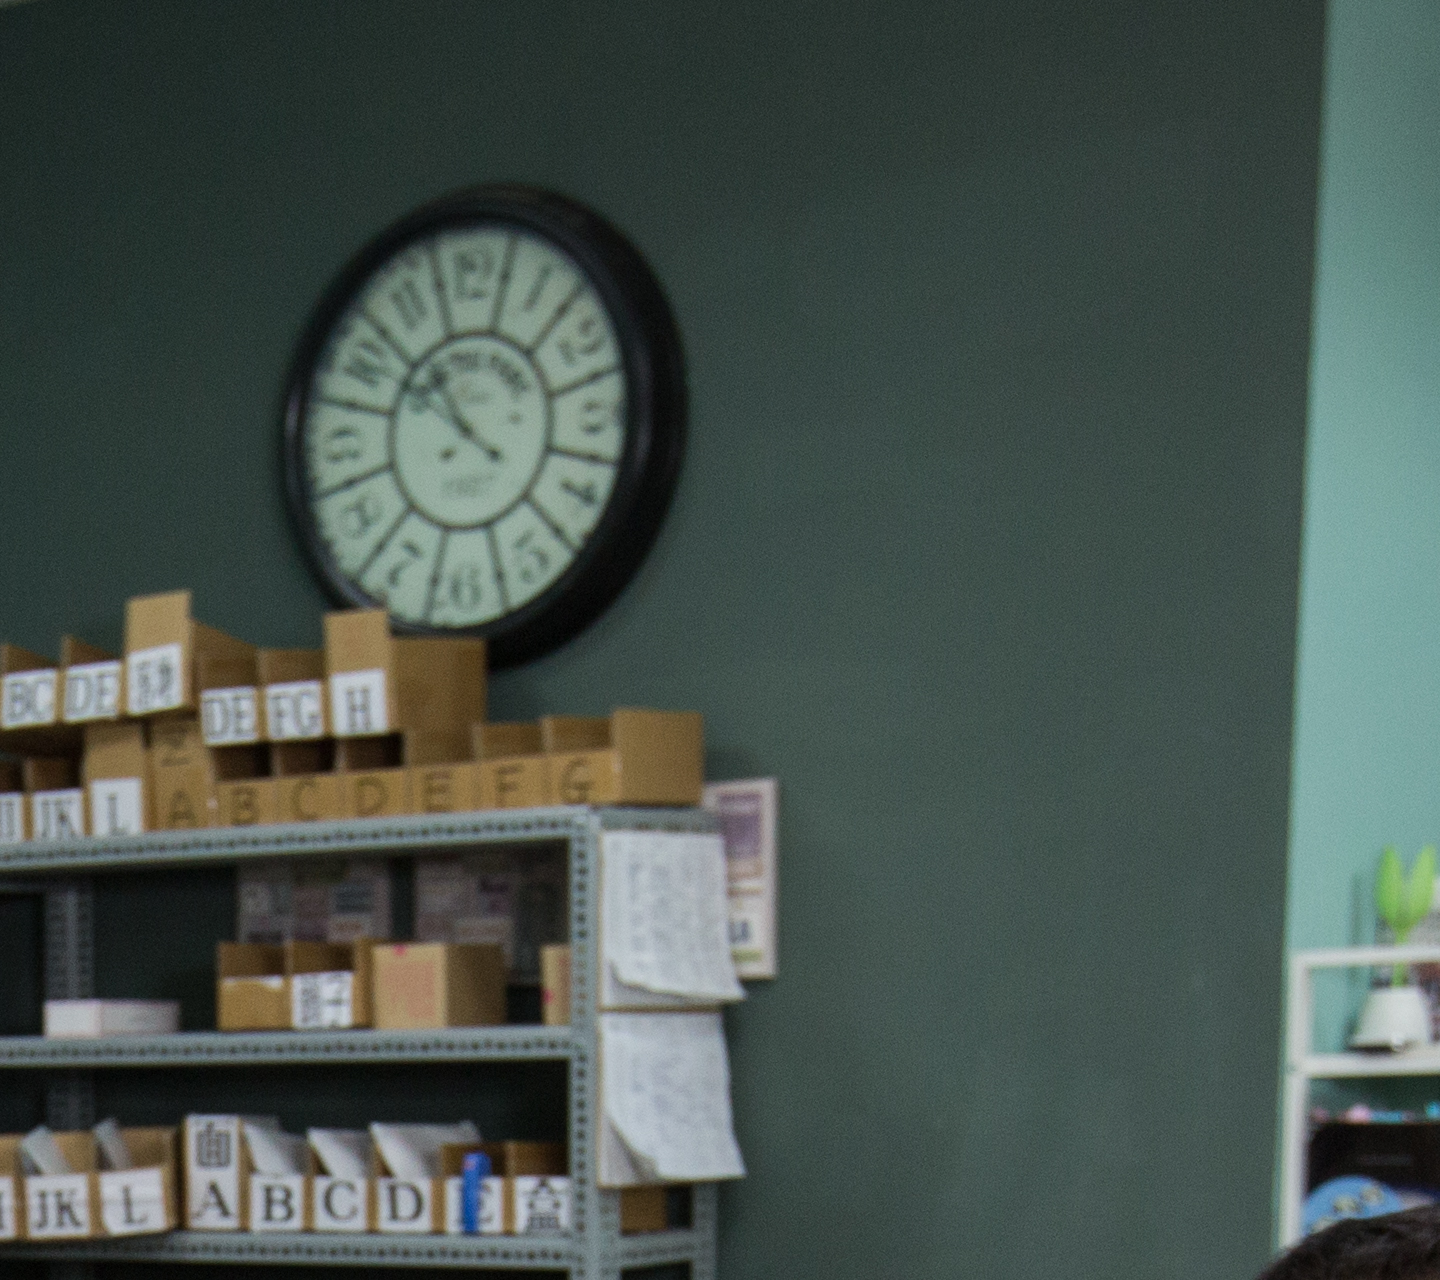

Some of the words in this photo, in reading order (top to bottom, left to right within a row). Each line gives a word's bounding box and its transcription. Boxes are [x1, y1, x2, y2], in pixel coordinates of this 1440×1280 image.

[7, 676, 52, 722] BC
[66, 668, 117, 718] DE
[205, 693, 255, 739] DE
[270, 688, 320, 736] FG
[346, 685, 371, 729] H
[233, 788, 259, 824] B
[292, 784, 320, 819] C
[356, 779, 387, 814] D
[425, 773, 453, 812] E
[496, 763, 525, 808] F
[562, 758, 595, 803] G
[108, 795, 130, 834] L
[36, 1188, 87, 1230] JK
[122, 1186, 148, 1226] L
[195, 1180, 237, 1221] A
[262, 1187, 295, 1222] B
[324, 1185, 358, 1223] C
[387, 1184, 423, 1222] D
